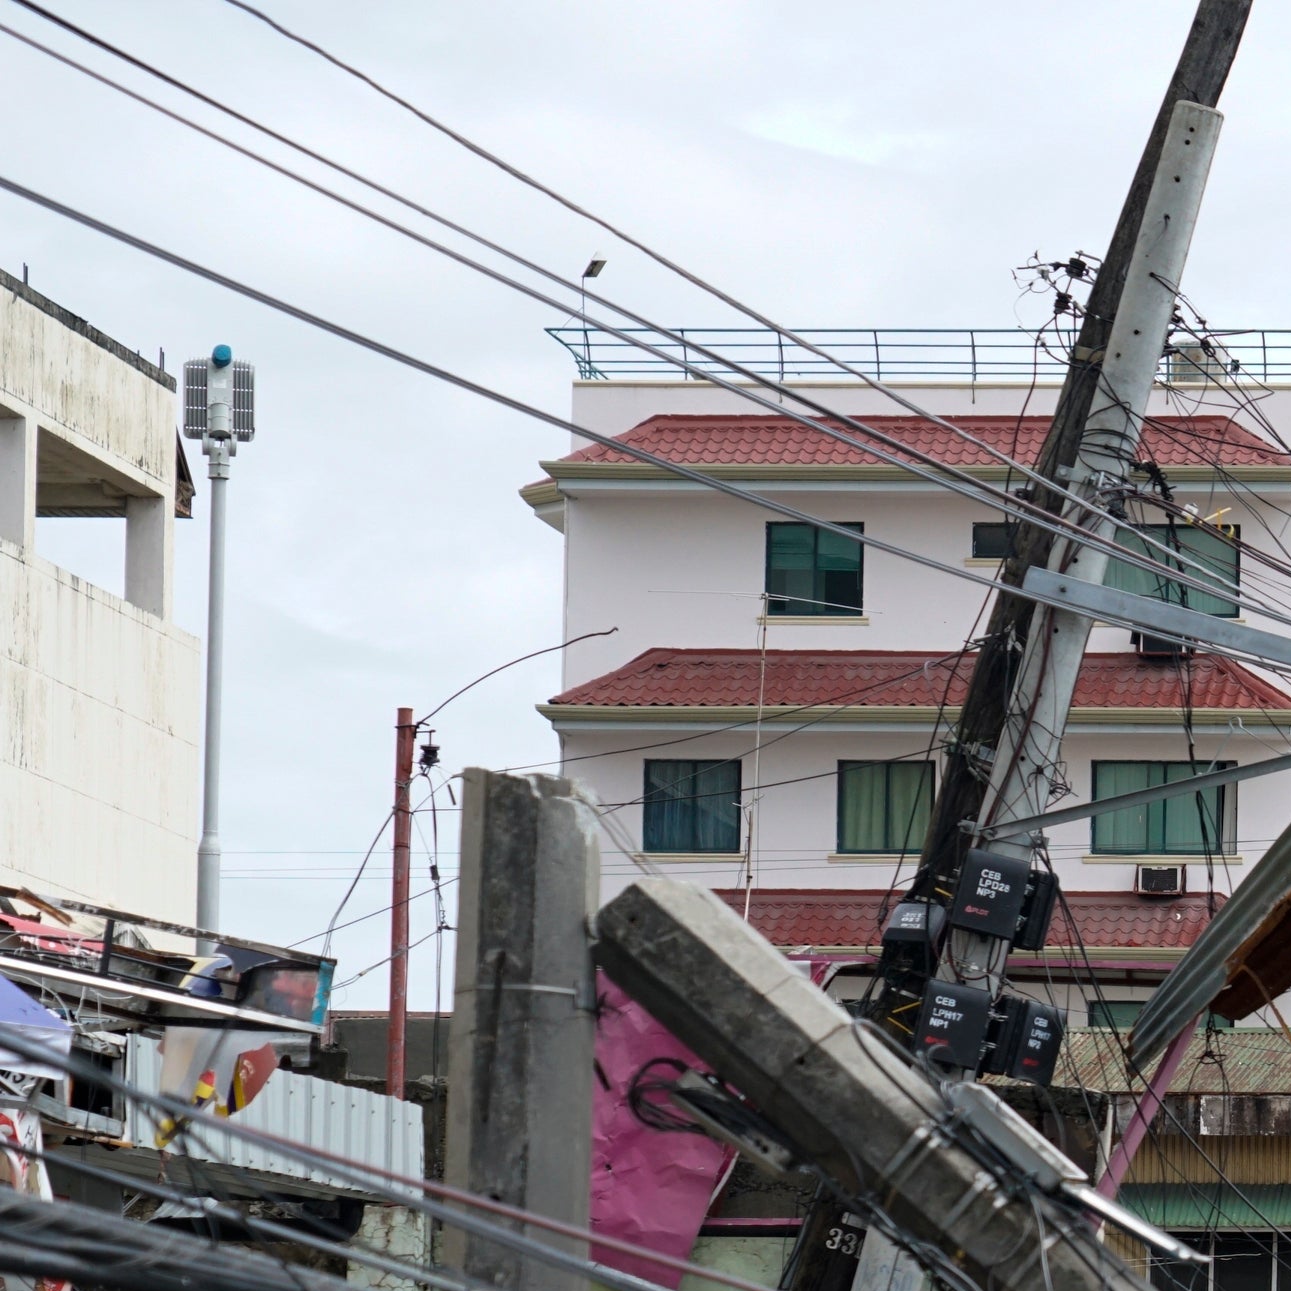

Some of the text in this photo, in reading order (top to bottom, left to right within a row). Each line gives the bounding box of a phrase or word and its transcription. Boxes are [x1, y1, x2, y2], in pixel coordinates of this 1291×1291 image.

[980, 868, 1002, 881] CEB
[976, 887, 996, 899] NP3
[935, 995, 957, 1008] CEB
[929, 1017, 949, 1029] NP1
[1034, 1016, 1049, 1028] CEB
